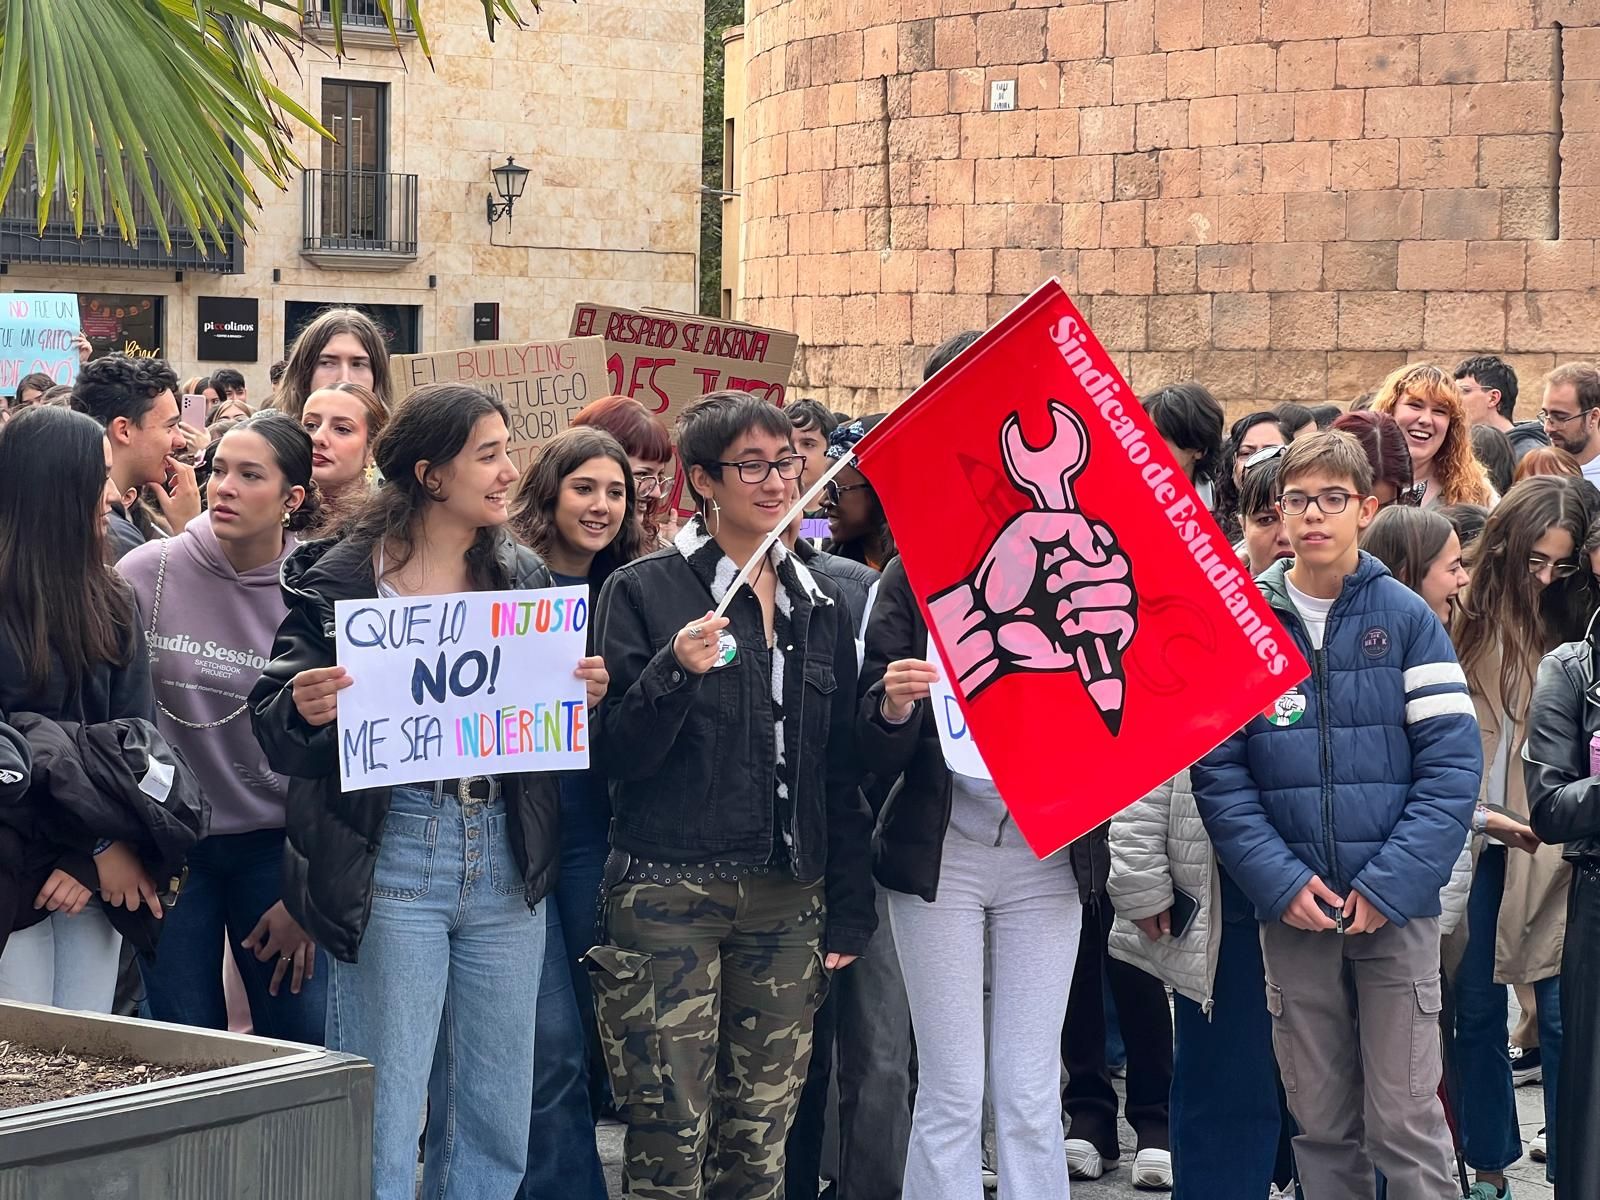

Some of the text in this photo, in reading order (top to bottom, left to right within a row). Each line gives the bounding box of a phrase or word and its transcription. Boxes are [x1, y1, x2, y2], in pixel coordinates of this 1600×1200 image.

[9, 301, 73, 319] NO FUE UN
[203, 321, 254, 333] piccolinos
[579, 308, 597, 337] EL
[604, 311, 678, 349] RESPETO
[682, 324, 704, 353] SE
[21, 328, 35, 348] UN
[38, 328, 73, 352] GRITO
[411, 357, 448, 387] EL
[456, 343, 577, 381] BULLYING
[508, 372, 588, 410] JUEGO
[1048, 315, 1289, 676] Sindicato de Estudiantes
[344, 597, 588, 650] QUE LO INJUSTO
[194, 658, 241, 675] SKETCHBOOK
[200, 666, 233, 679] PROJECT
[411, 645, 501, 706] NO!
[344, 699, 586, 778] ME SEA INDIFERENTE
